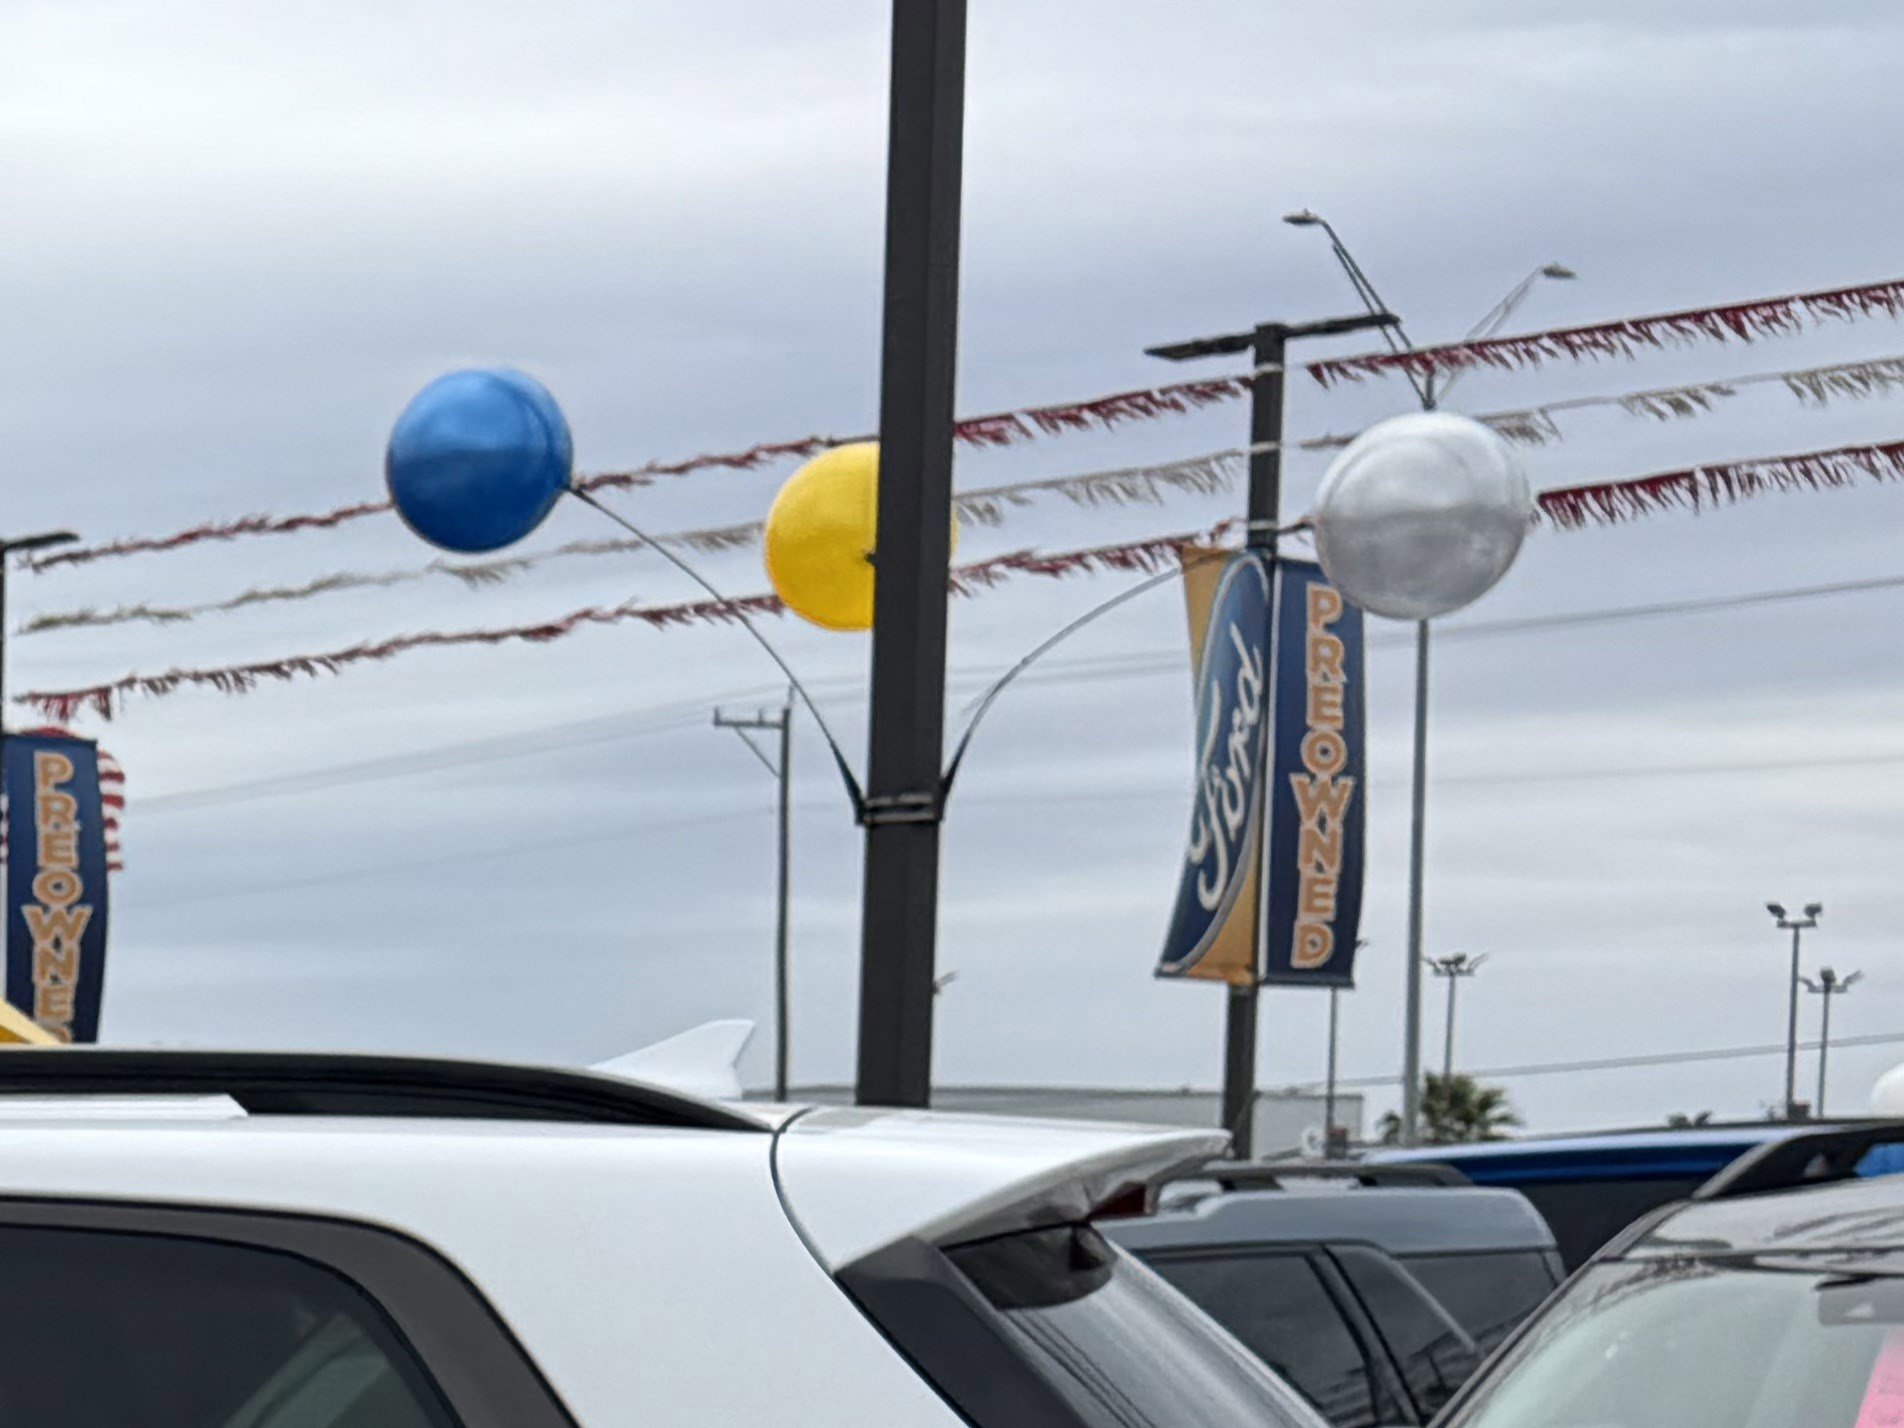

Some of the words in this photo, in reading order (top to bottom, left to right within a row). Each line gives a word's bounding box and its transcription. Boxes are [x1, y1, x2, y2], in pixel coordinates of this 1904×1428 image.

[20, 751, 94, 1044] PREOWNE
[1190, 621, 1263, 911] Ford
[1289, 582, 1357, 969] PREOWNED
